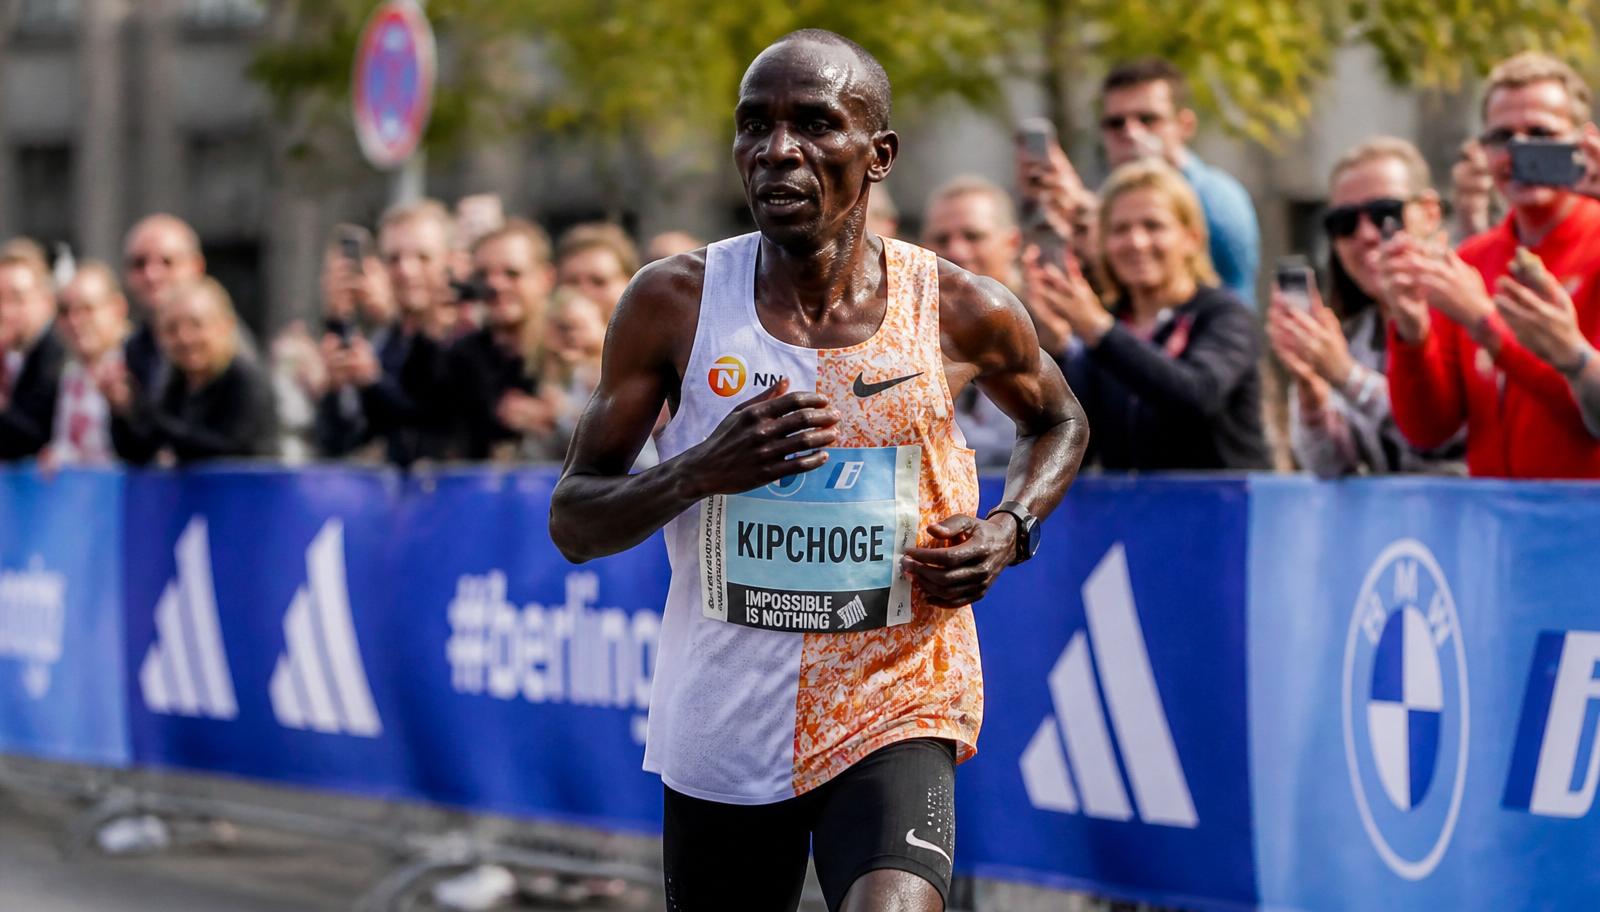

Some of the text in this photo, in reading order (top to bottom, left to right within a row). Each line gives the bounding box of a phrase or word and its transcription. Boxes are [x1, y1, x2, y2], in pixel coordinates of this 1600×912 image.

[737, 520, 884, 564] KIPCHOGE
[745, 589, 833, 613] IMPOSSIBLE
[746, 606, 830, 630] IS NOTHING
